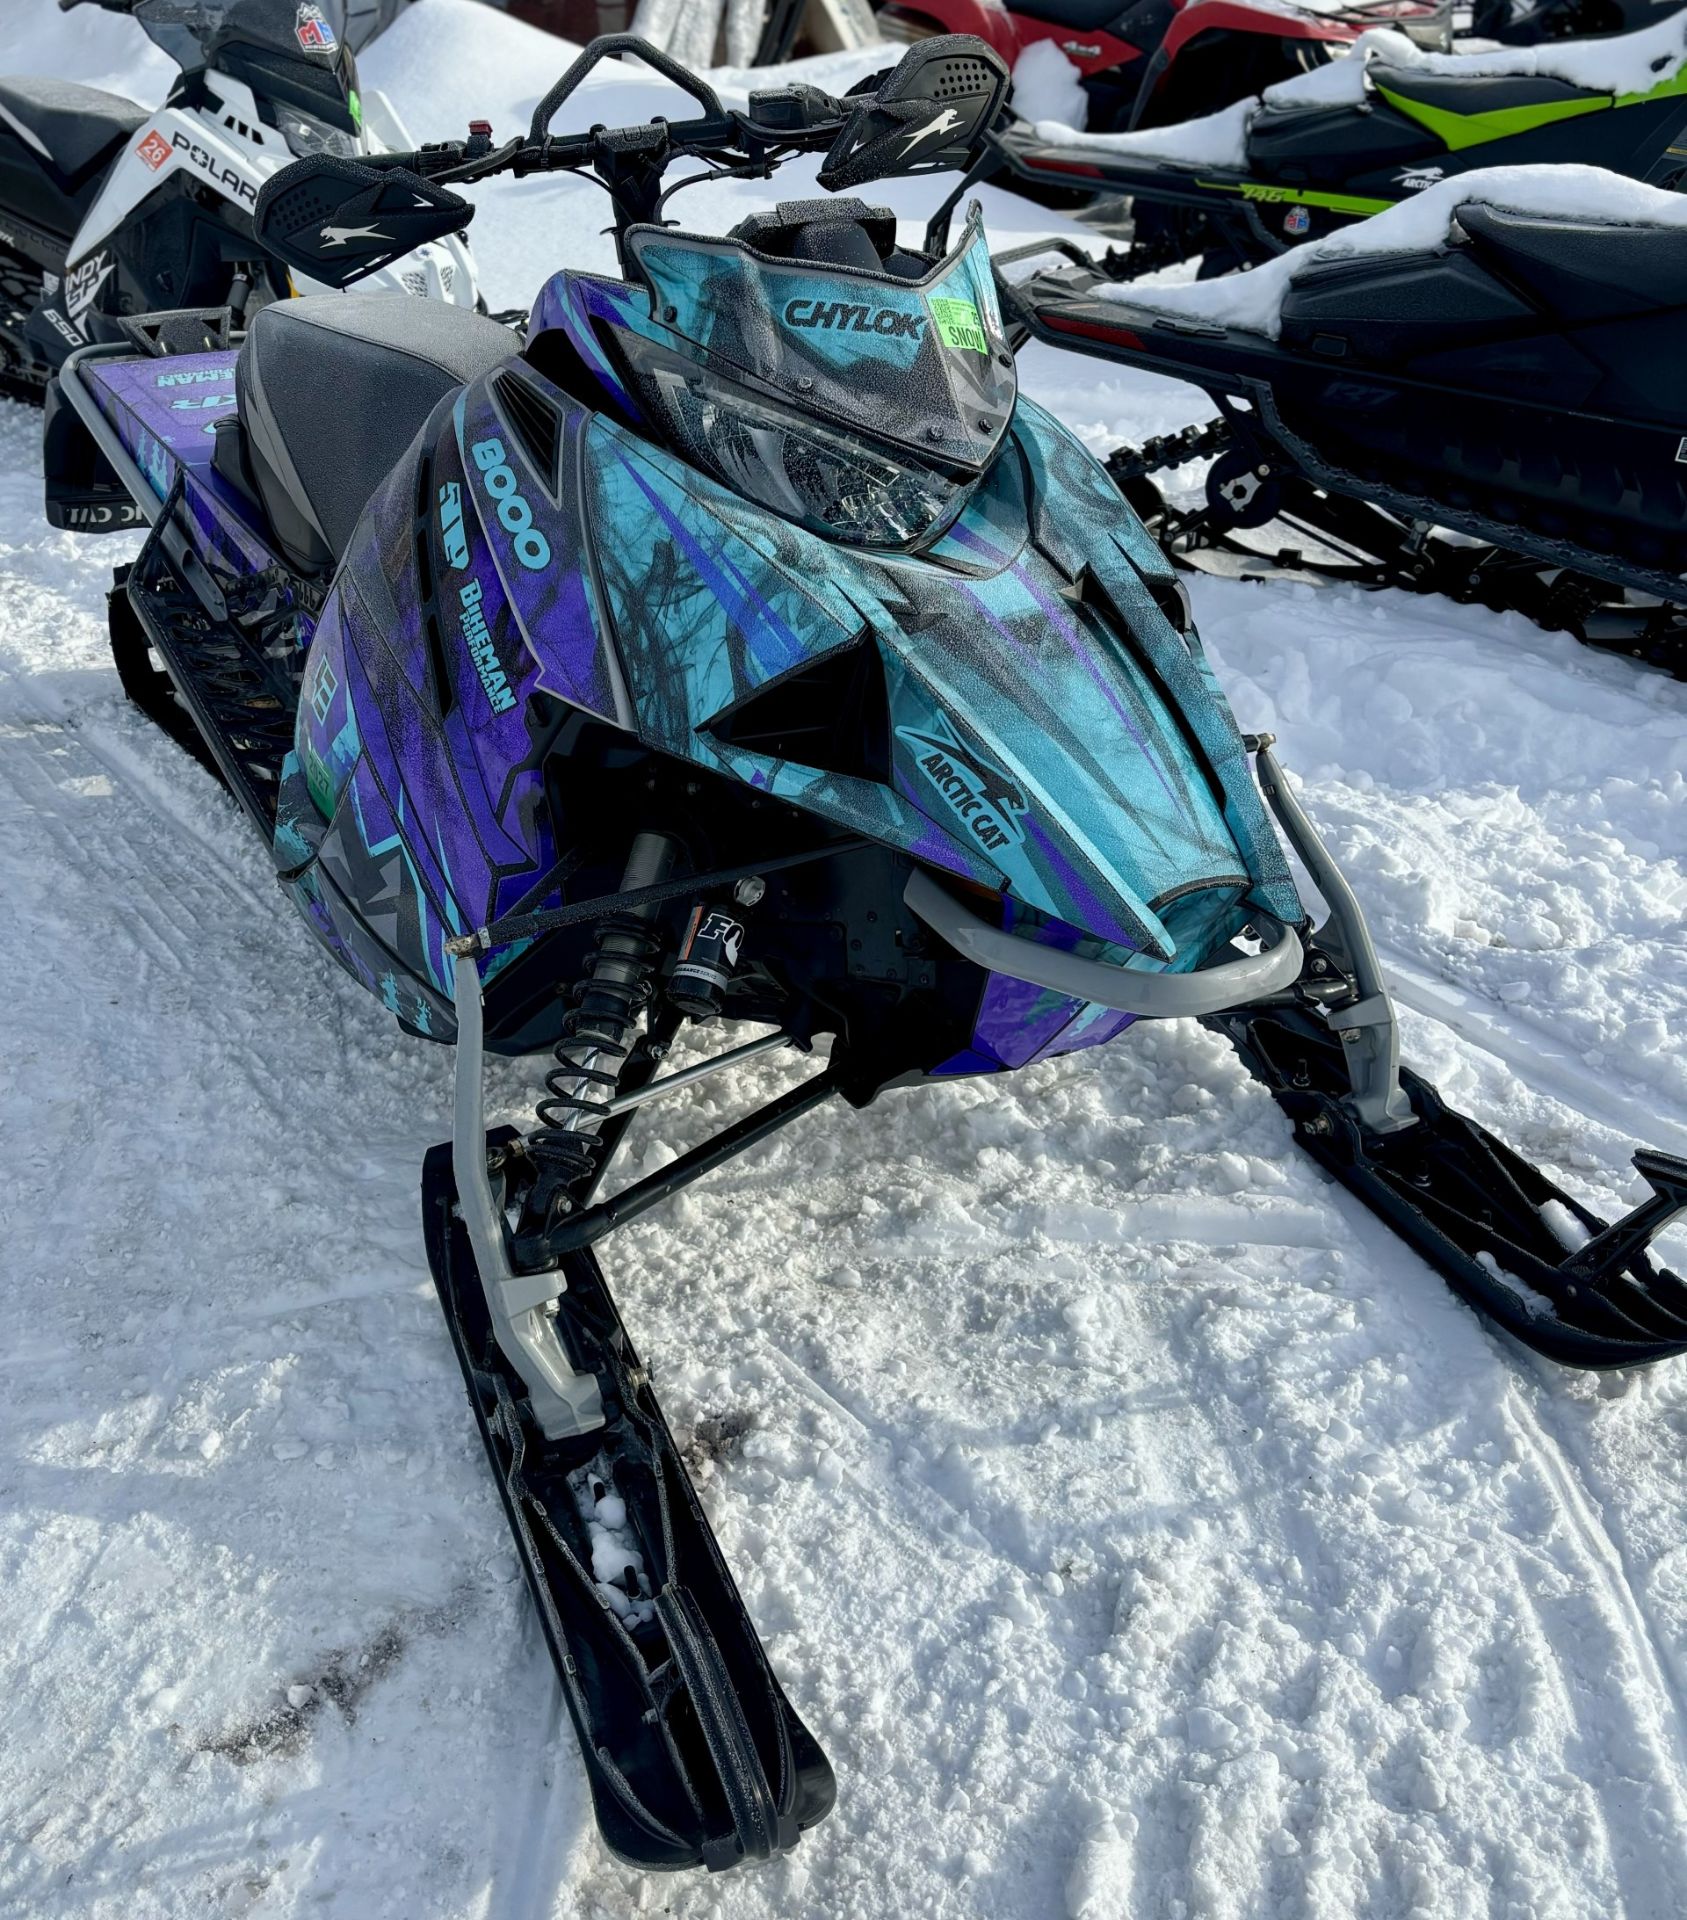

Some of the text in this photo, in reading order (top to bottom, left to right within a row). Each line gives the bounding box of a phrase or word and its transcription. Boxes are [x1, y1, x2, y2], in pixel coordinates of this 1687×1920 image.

[143, 138, 166, 161] 26
[172, 131, 258, 206] POLAR
[65, 250, 107, 295] INDY
[42, 309, 84, 346] 650
[784, 299, 928, 341] CHYLOK
[948, 326, 984, 351] SNOW
[471, 437, 551, 570] 8000
[459, 577, 517, 711] BIKEMAN
[459, 610, 502, 714] PERFORMANCE
[920, 752, 1011, 851] ARCTIC CAT
[697, 912, 745, 964] FO
